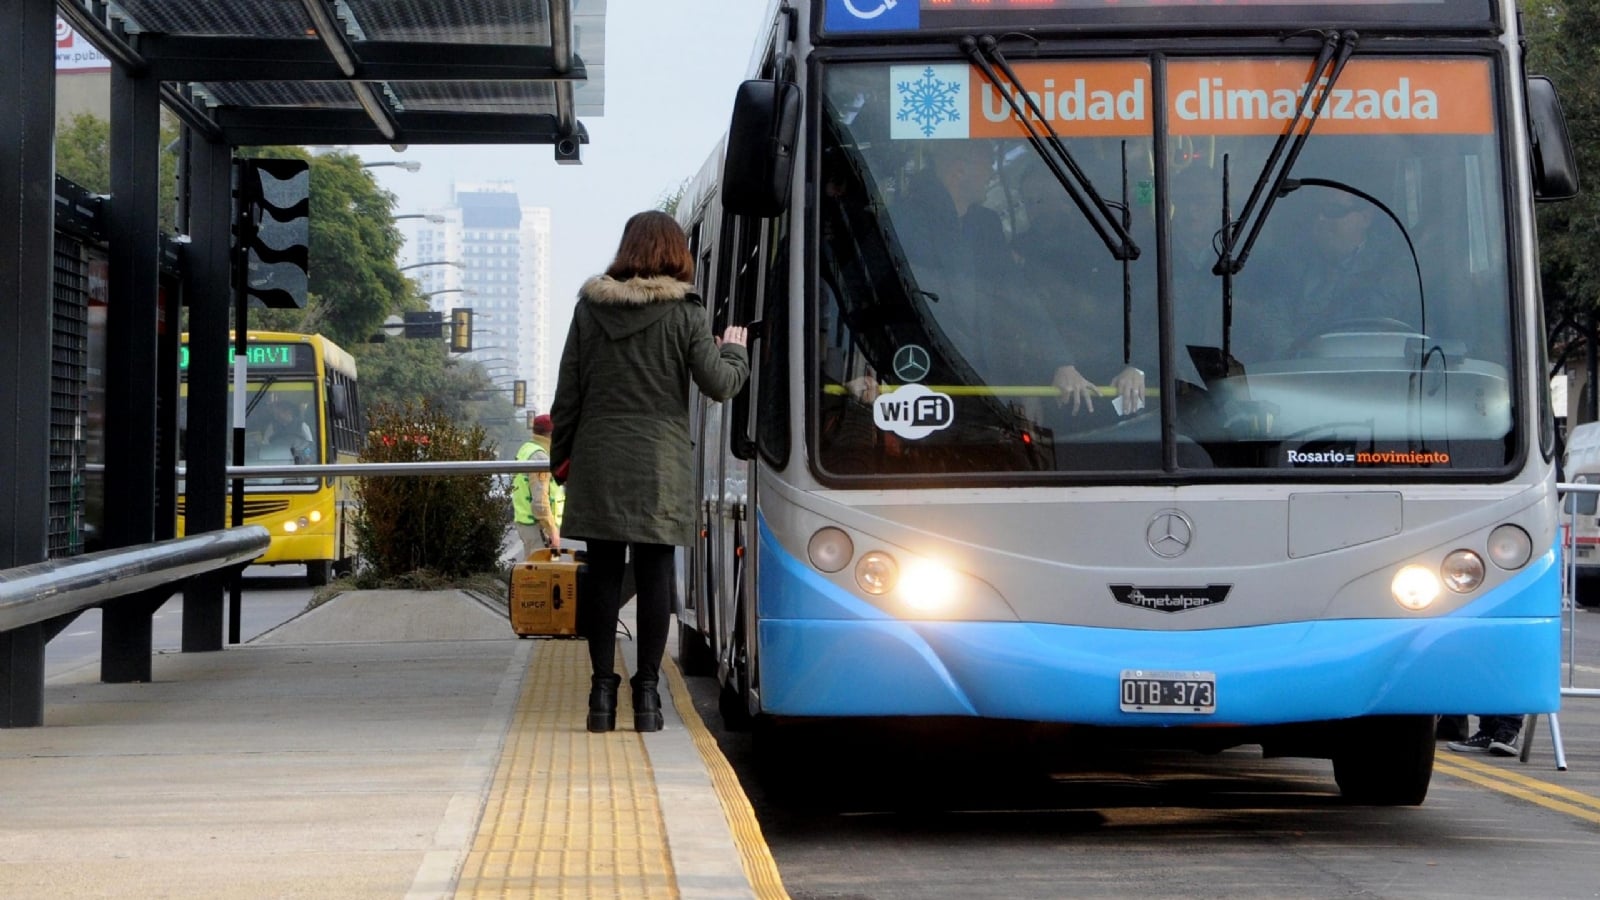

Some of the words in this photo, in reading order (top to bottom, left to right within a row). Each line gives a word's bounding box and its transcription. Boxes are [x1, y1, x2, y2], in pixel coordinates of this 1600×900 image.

[981, 78, 1145, 122] Unidad
[1175, 77, 1438, 121] climatizada
[1357, 450, 1450, 464] movimiento
[1142, 594, 1210, 609] metalpar
[1124, 681, 1161, 704] OTB
[1174, 682, 1212, 705] 373
